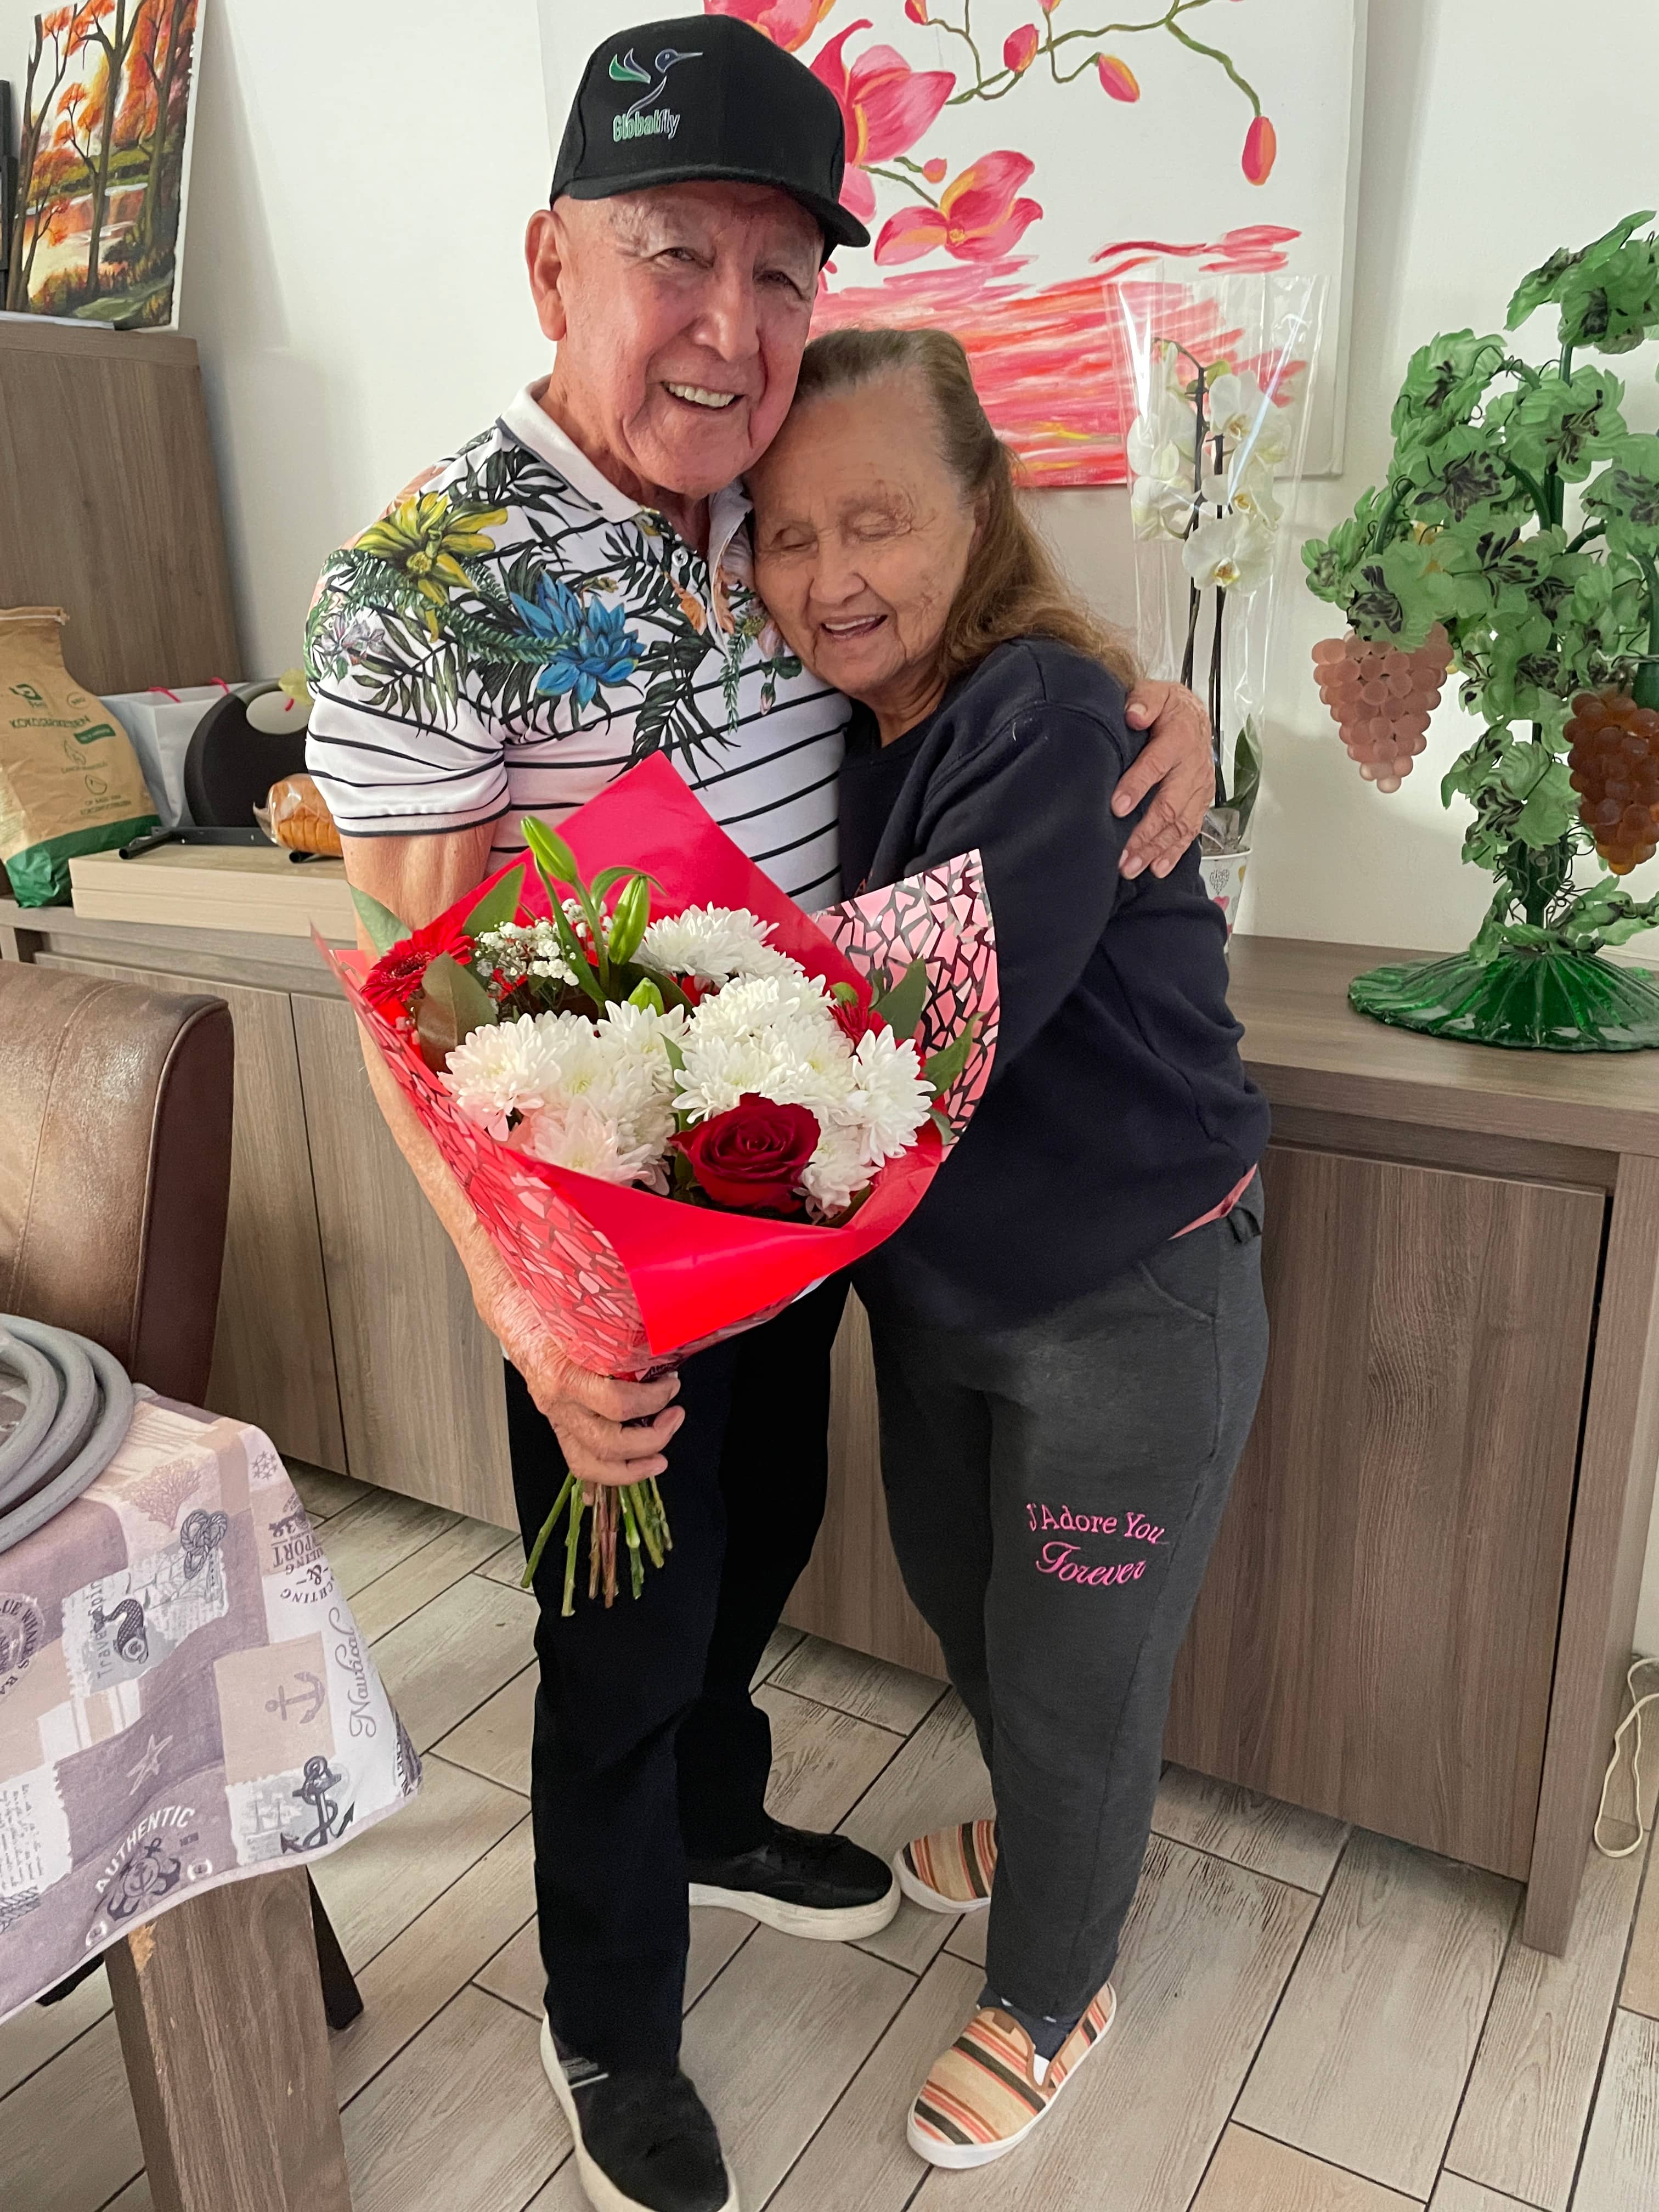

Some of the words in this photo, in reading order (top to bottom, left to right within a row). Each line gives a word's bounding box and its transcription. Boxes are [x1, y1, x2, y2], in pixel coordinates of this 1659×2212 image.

[613, 109, 680, 142] Globalfly
[1124, 1511, 1165, 1544] You
[307, 1564, 322, 1585] &
[1035, 1541, 1147, 1585] Forever
[280, 1576, 334, 1604] CHTING
[0, 1599, 22, 1616] UE
[91, 1628, 114, 1679] Trave
[329, 1606, 376, 1739] Nautical
[95, 1804, 196, 1893] AUTHENTIC
